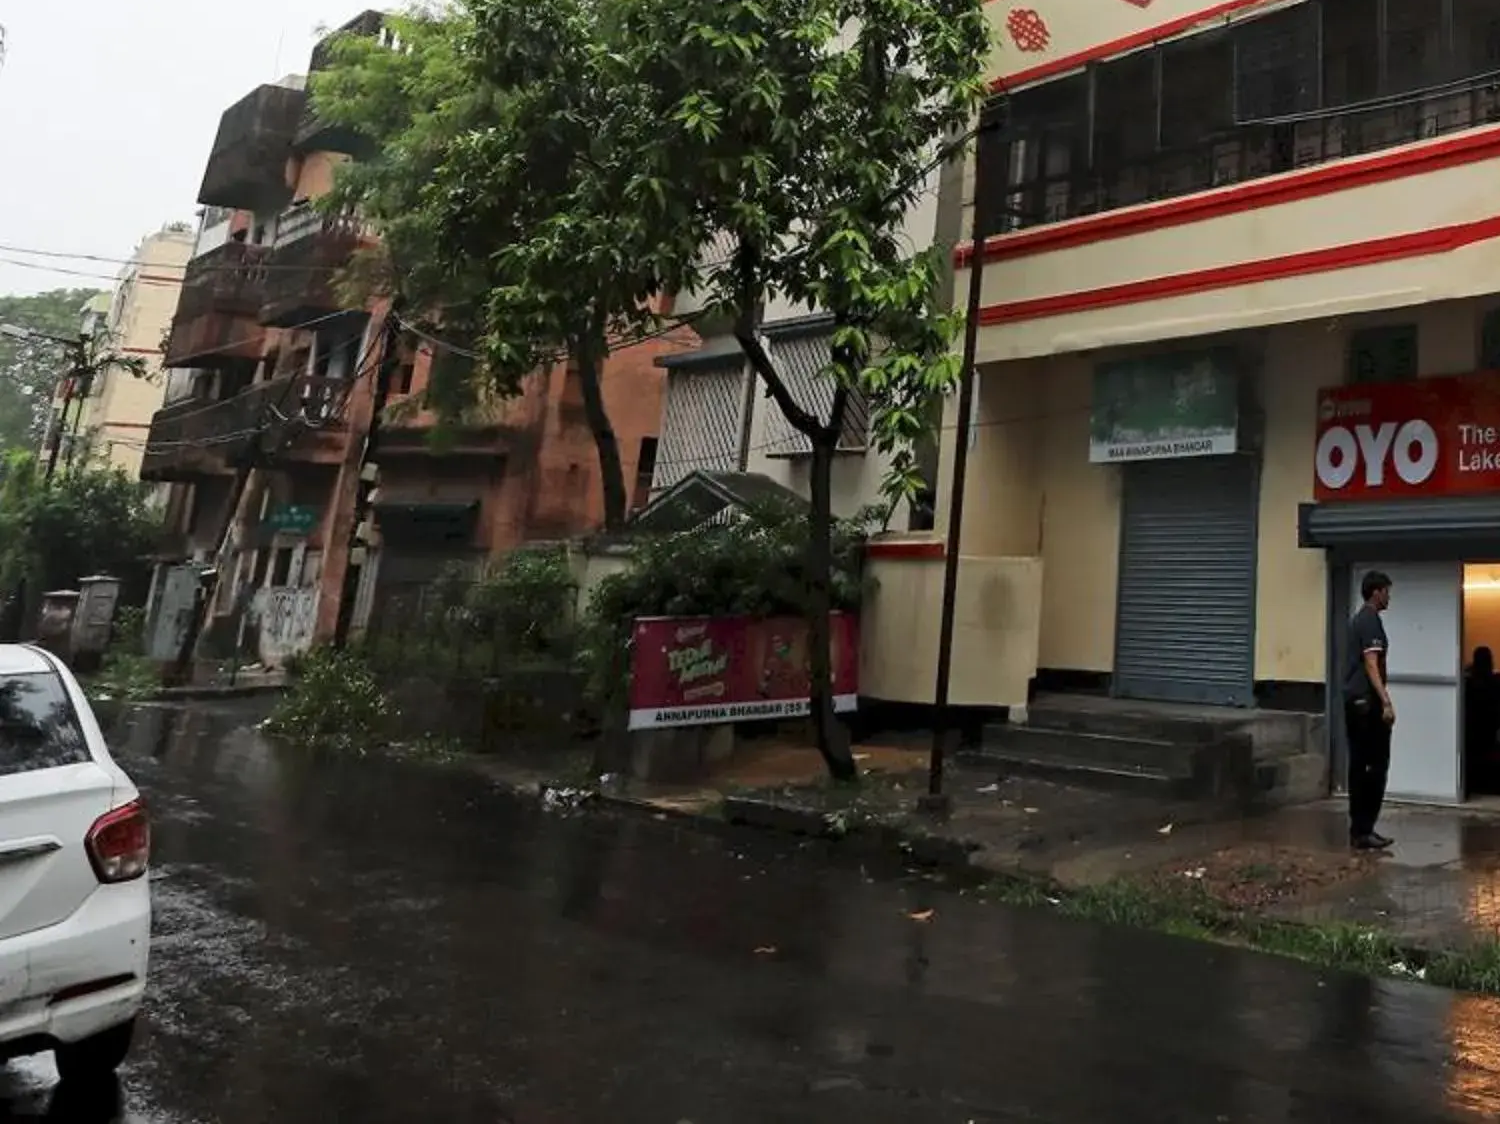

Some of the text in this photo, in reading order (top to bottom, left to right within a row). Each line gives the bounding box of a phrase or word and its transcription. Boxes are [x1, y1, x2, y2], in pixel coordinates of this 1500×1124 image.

[1458, 425, 1497, 445] The
[1315, 419, 1440, 490] OYO
[655, 707, 728, 722] ANNAPURNA
[729, 702, 783, 717] BHANDAR
